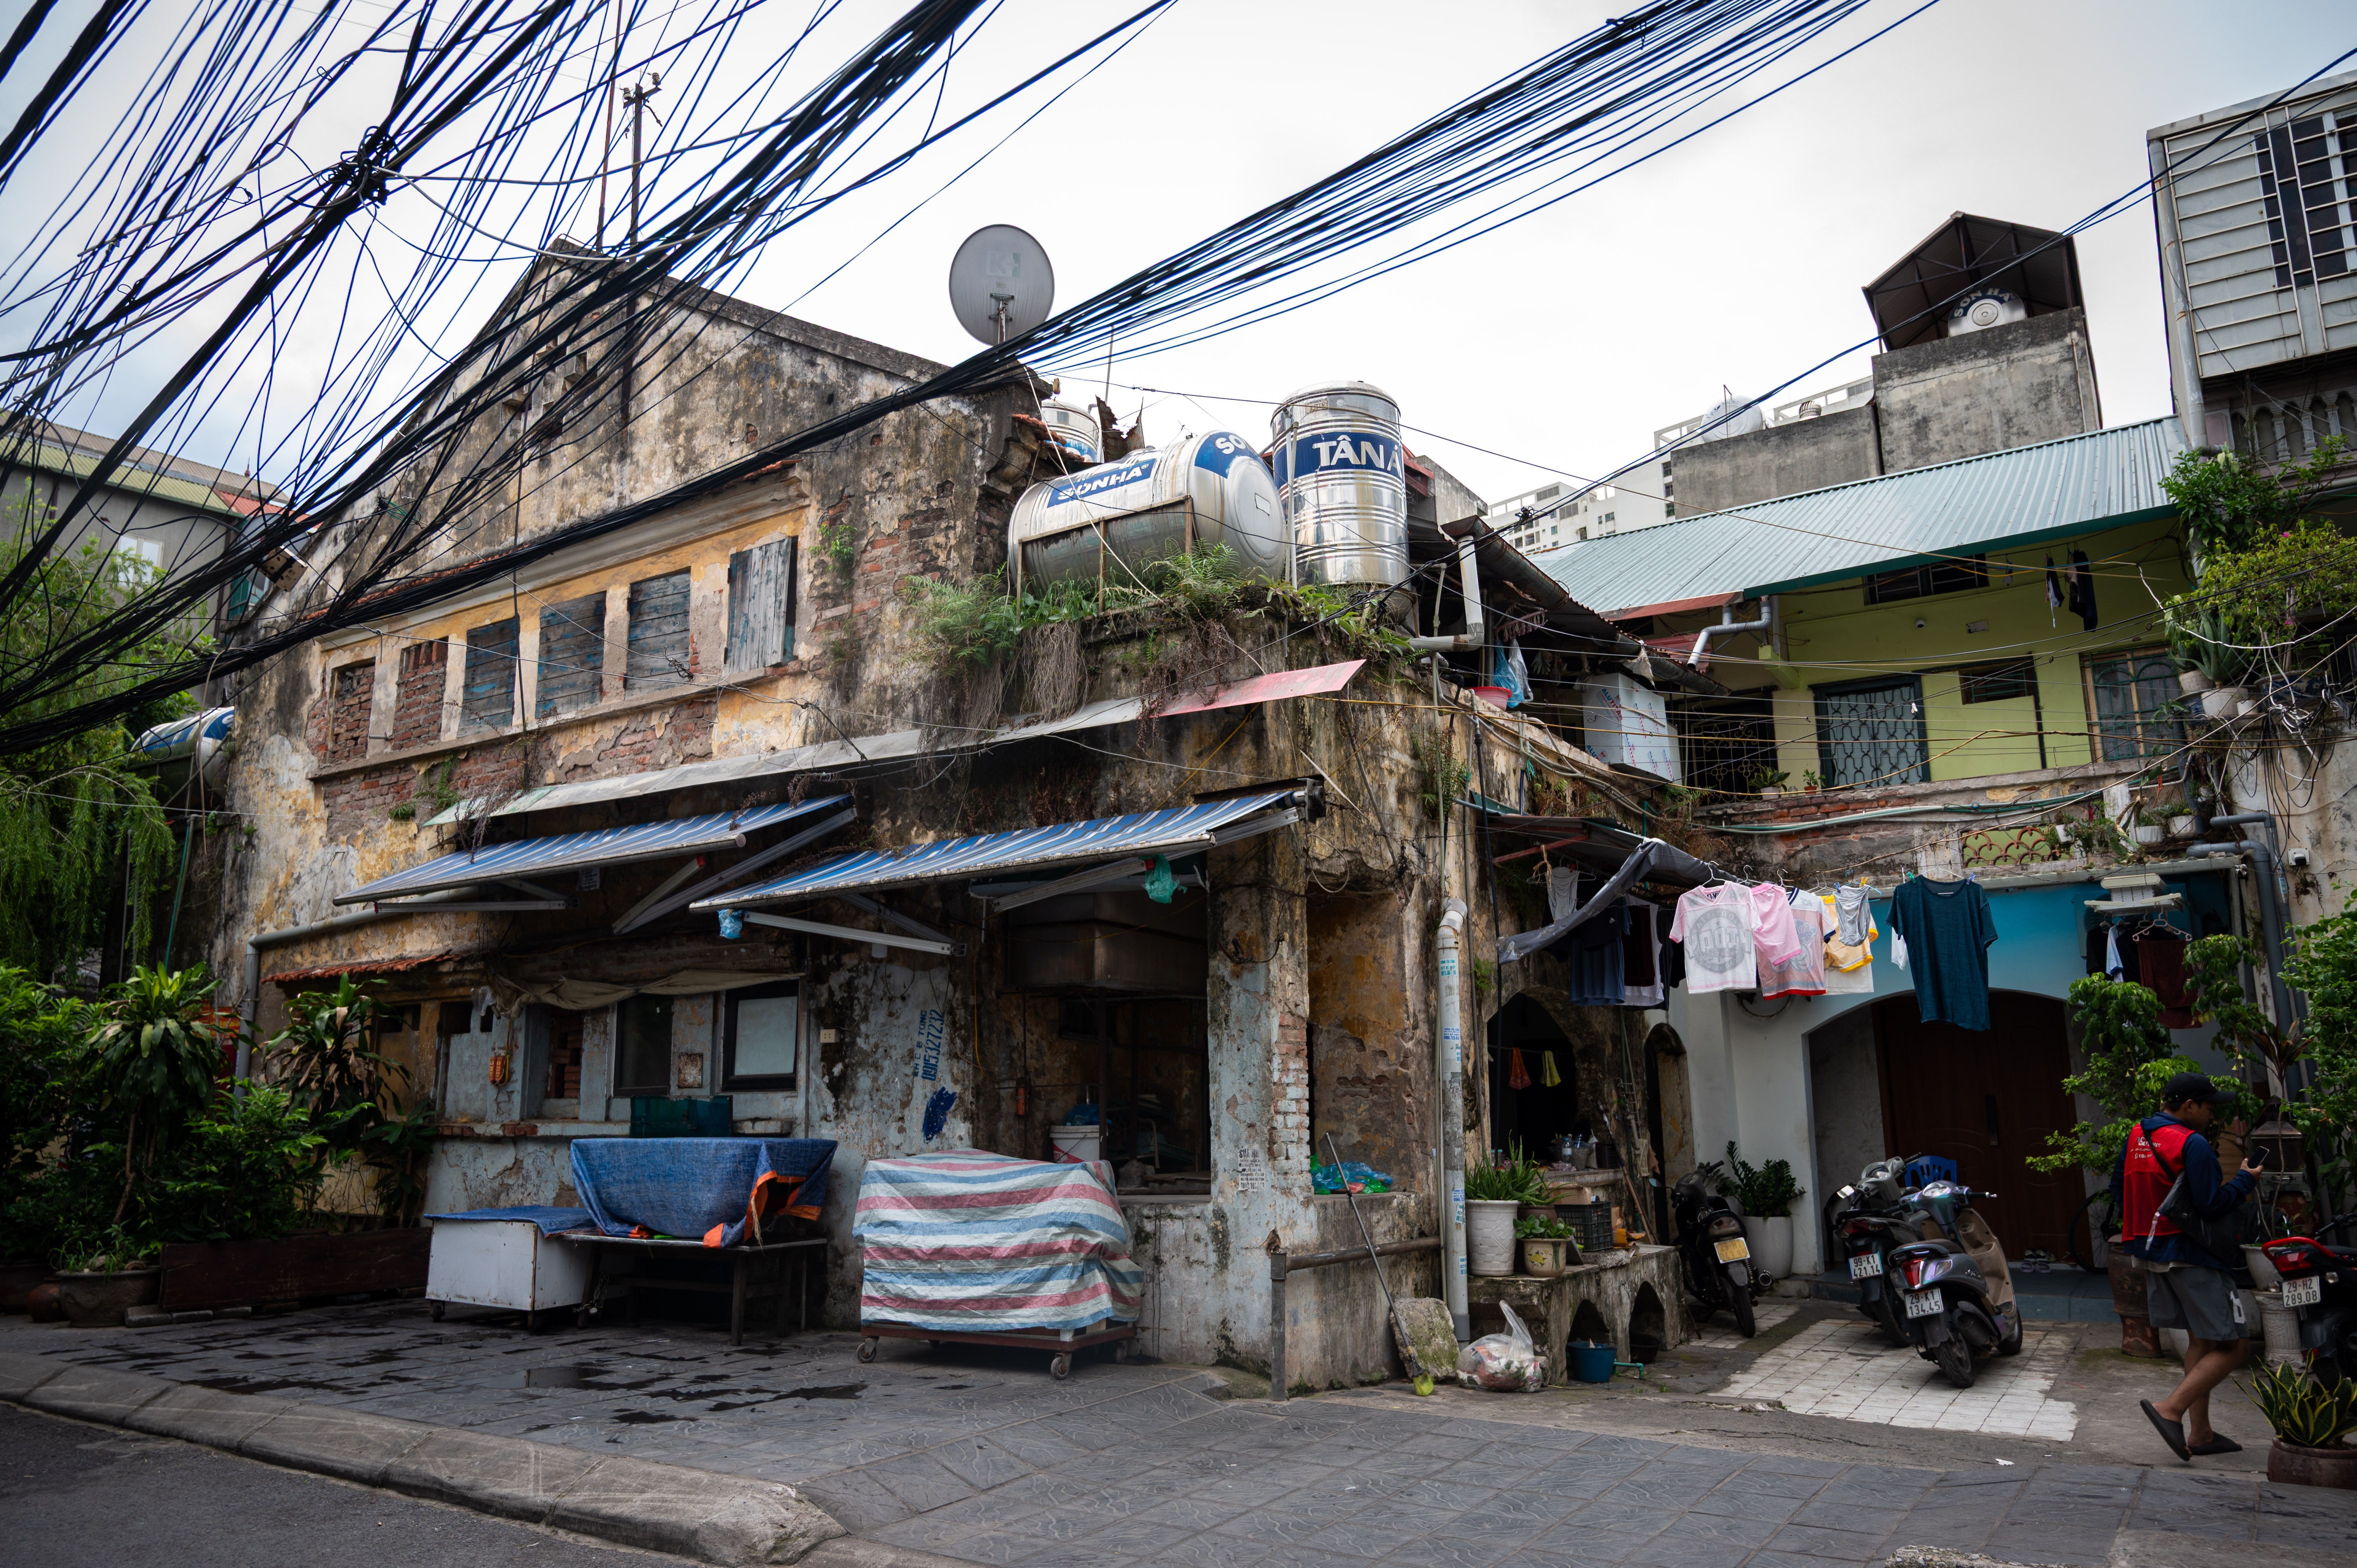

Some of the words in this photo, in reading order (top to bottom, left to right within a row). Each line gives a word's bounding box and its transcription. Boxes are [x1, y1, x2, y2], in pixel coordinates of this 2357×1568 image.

[1587, 745, 1600, 761] ALUT
[921, 1009, 945, 1081] 0915327232
[1854, 1254, 1875, 1267] 99-K1
[1854, 1264, 1880, 1277] 421.14
[2287, 1278, 2313, 1293] 29-H2
[1909, 1291, 1935, 1304] 29-K1
[2285, 1290, 2317, 1306] 289.08
[1909, 1301, 1941, 1316] 134.45
